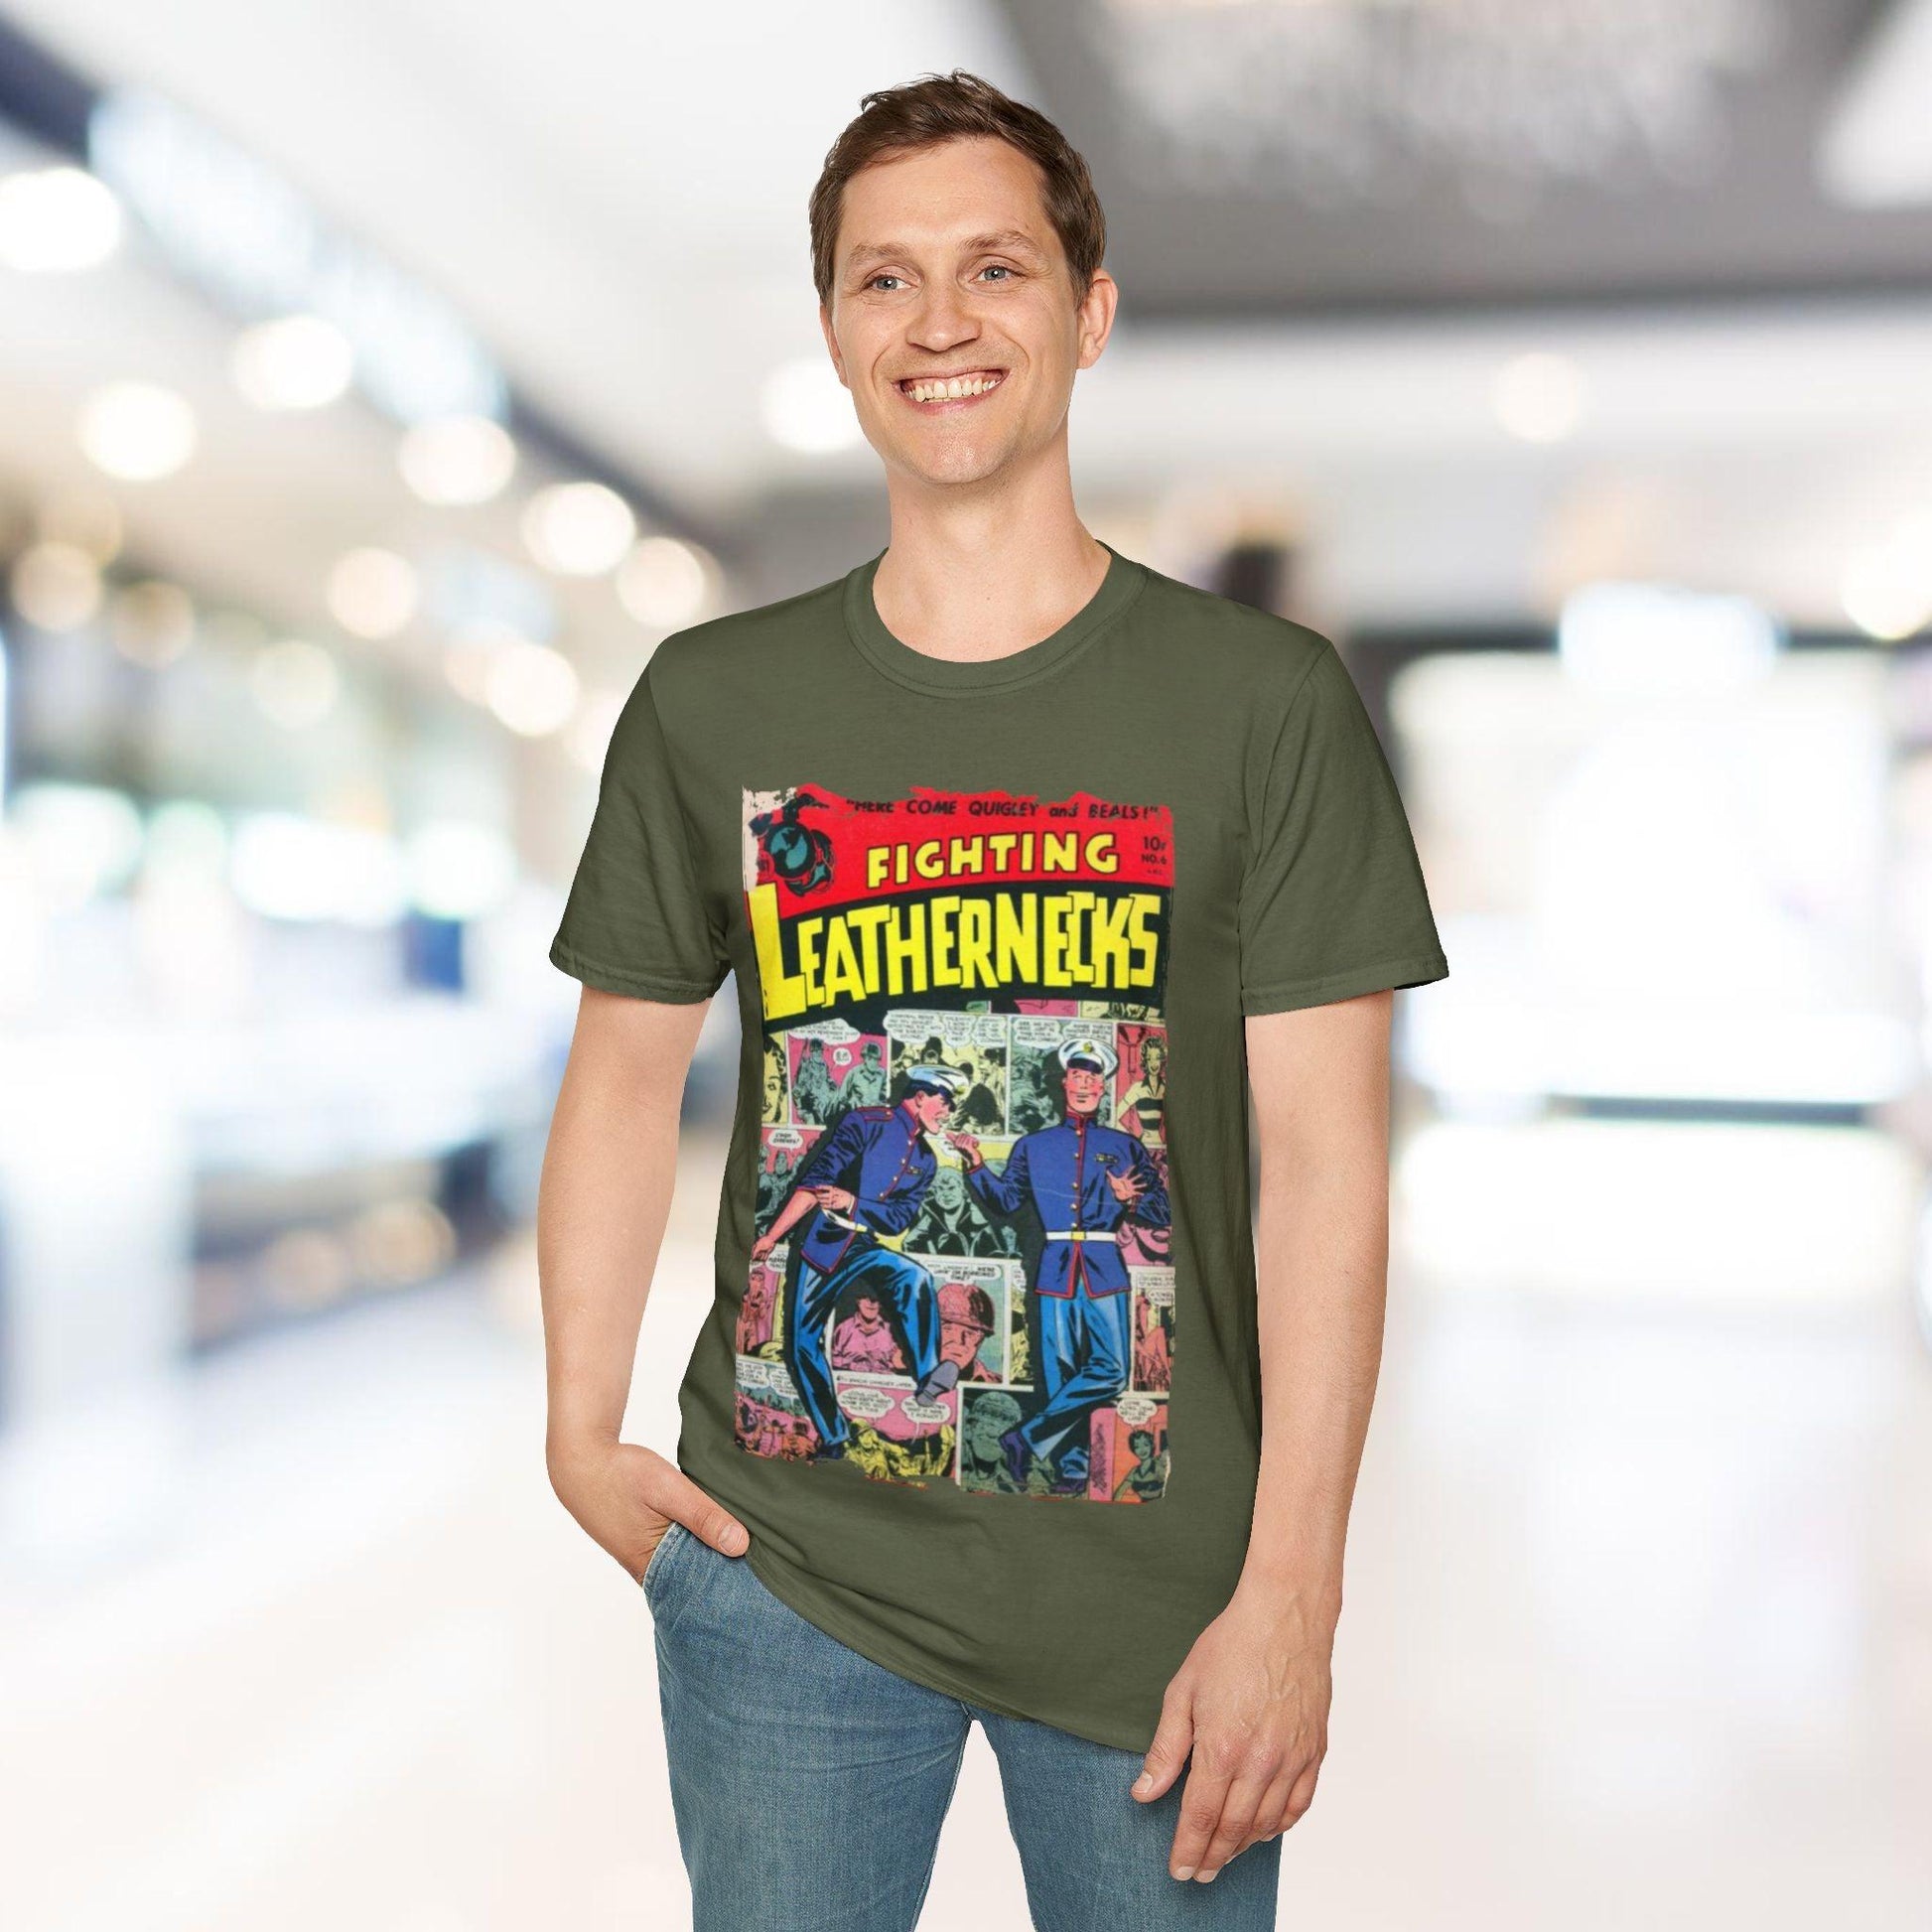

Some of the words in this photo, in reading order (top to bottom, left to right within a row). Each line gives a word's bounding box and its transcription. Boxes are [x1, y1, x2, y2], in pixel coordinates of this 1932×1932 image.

[906, 799, 957, 814] COME
[968, 800, 1040, 818] QUIGLEY
[1048, 802, 1079, 818] and
[866, 831, 1122, 890] FIGHTING
[747, 882, 1162, 1022] LEATHERNECKS
